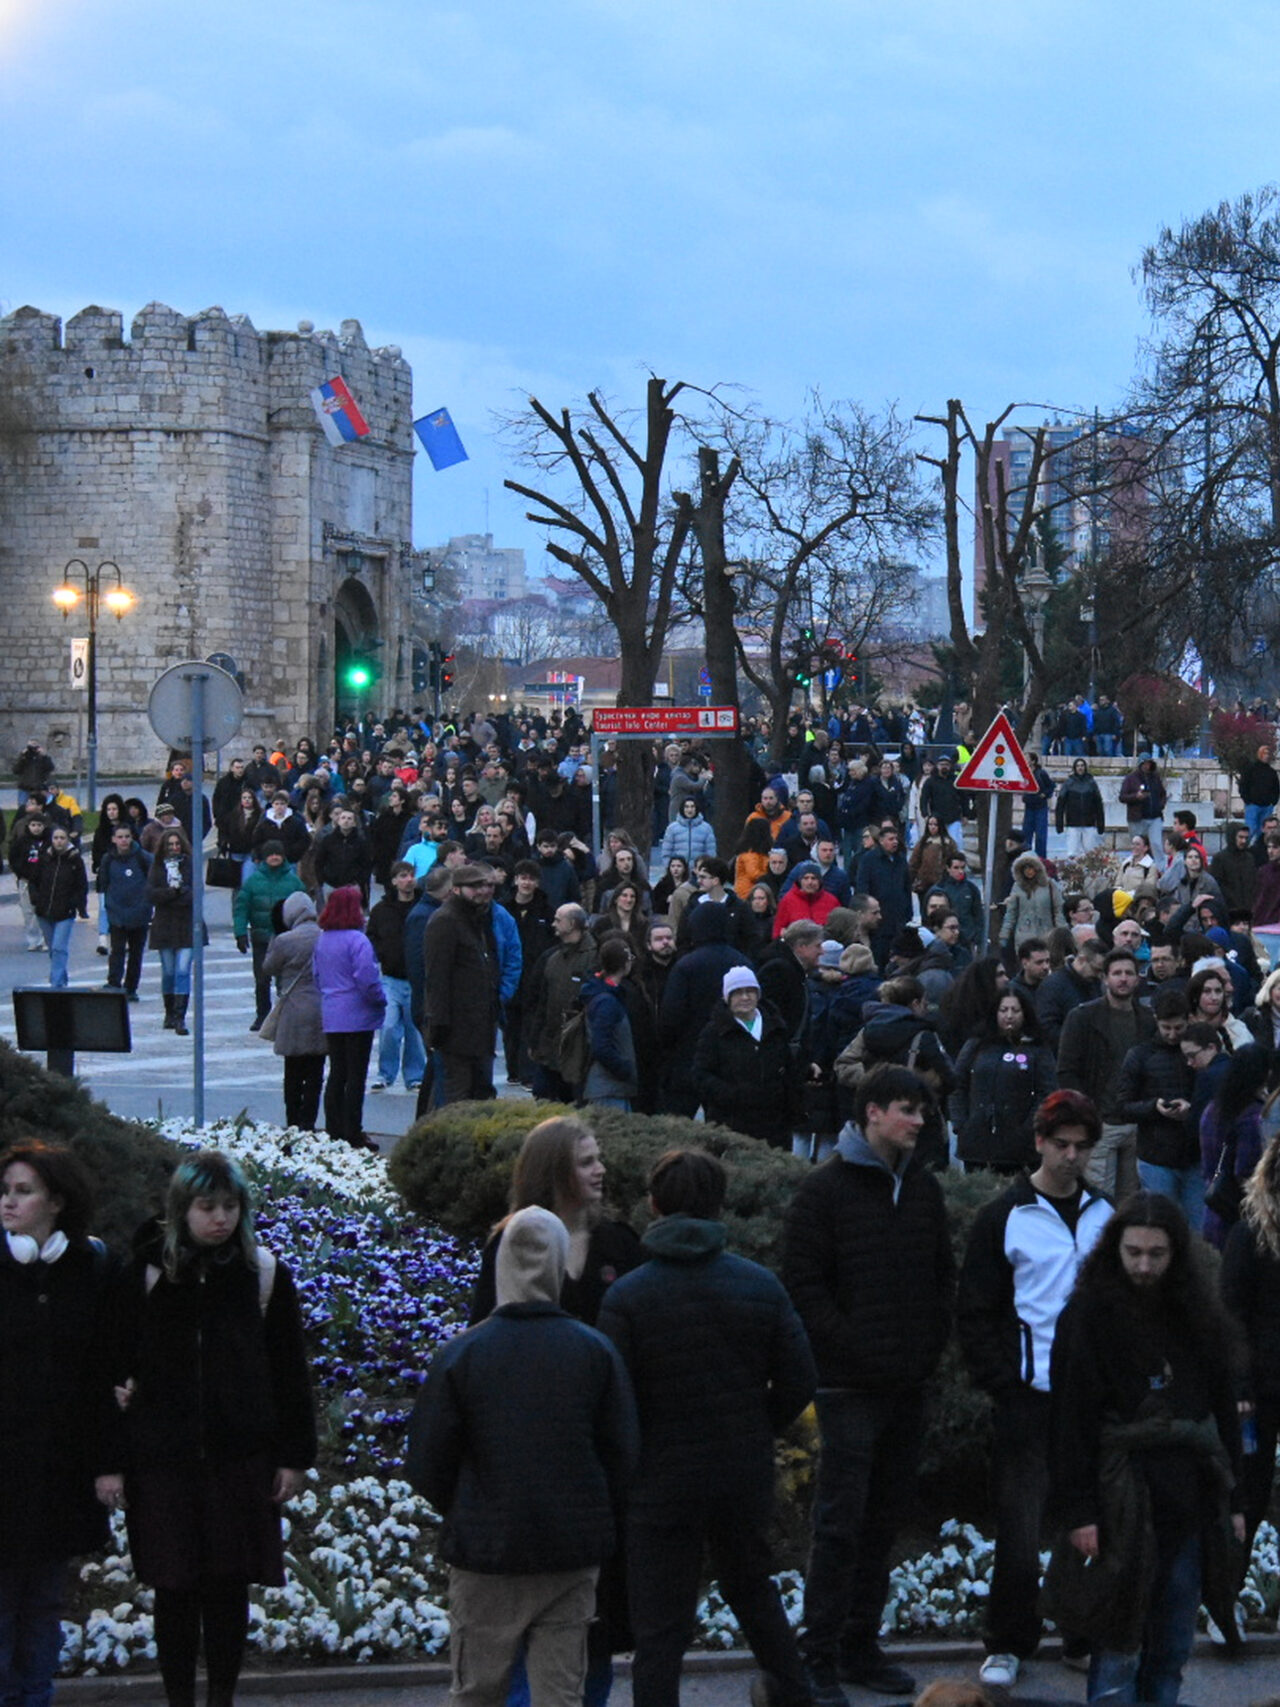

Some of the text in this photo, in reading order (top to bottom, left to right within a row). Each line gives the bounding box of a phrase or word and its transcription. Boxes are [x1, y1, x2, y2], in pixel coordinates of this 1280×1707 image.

[595, 721, 622, 729] Tourist
[625, 720, 641, 729] Info
[644, 720, 668, 729] Center
